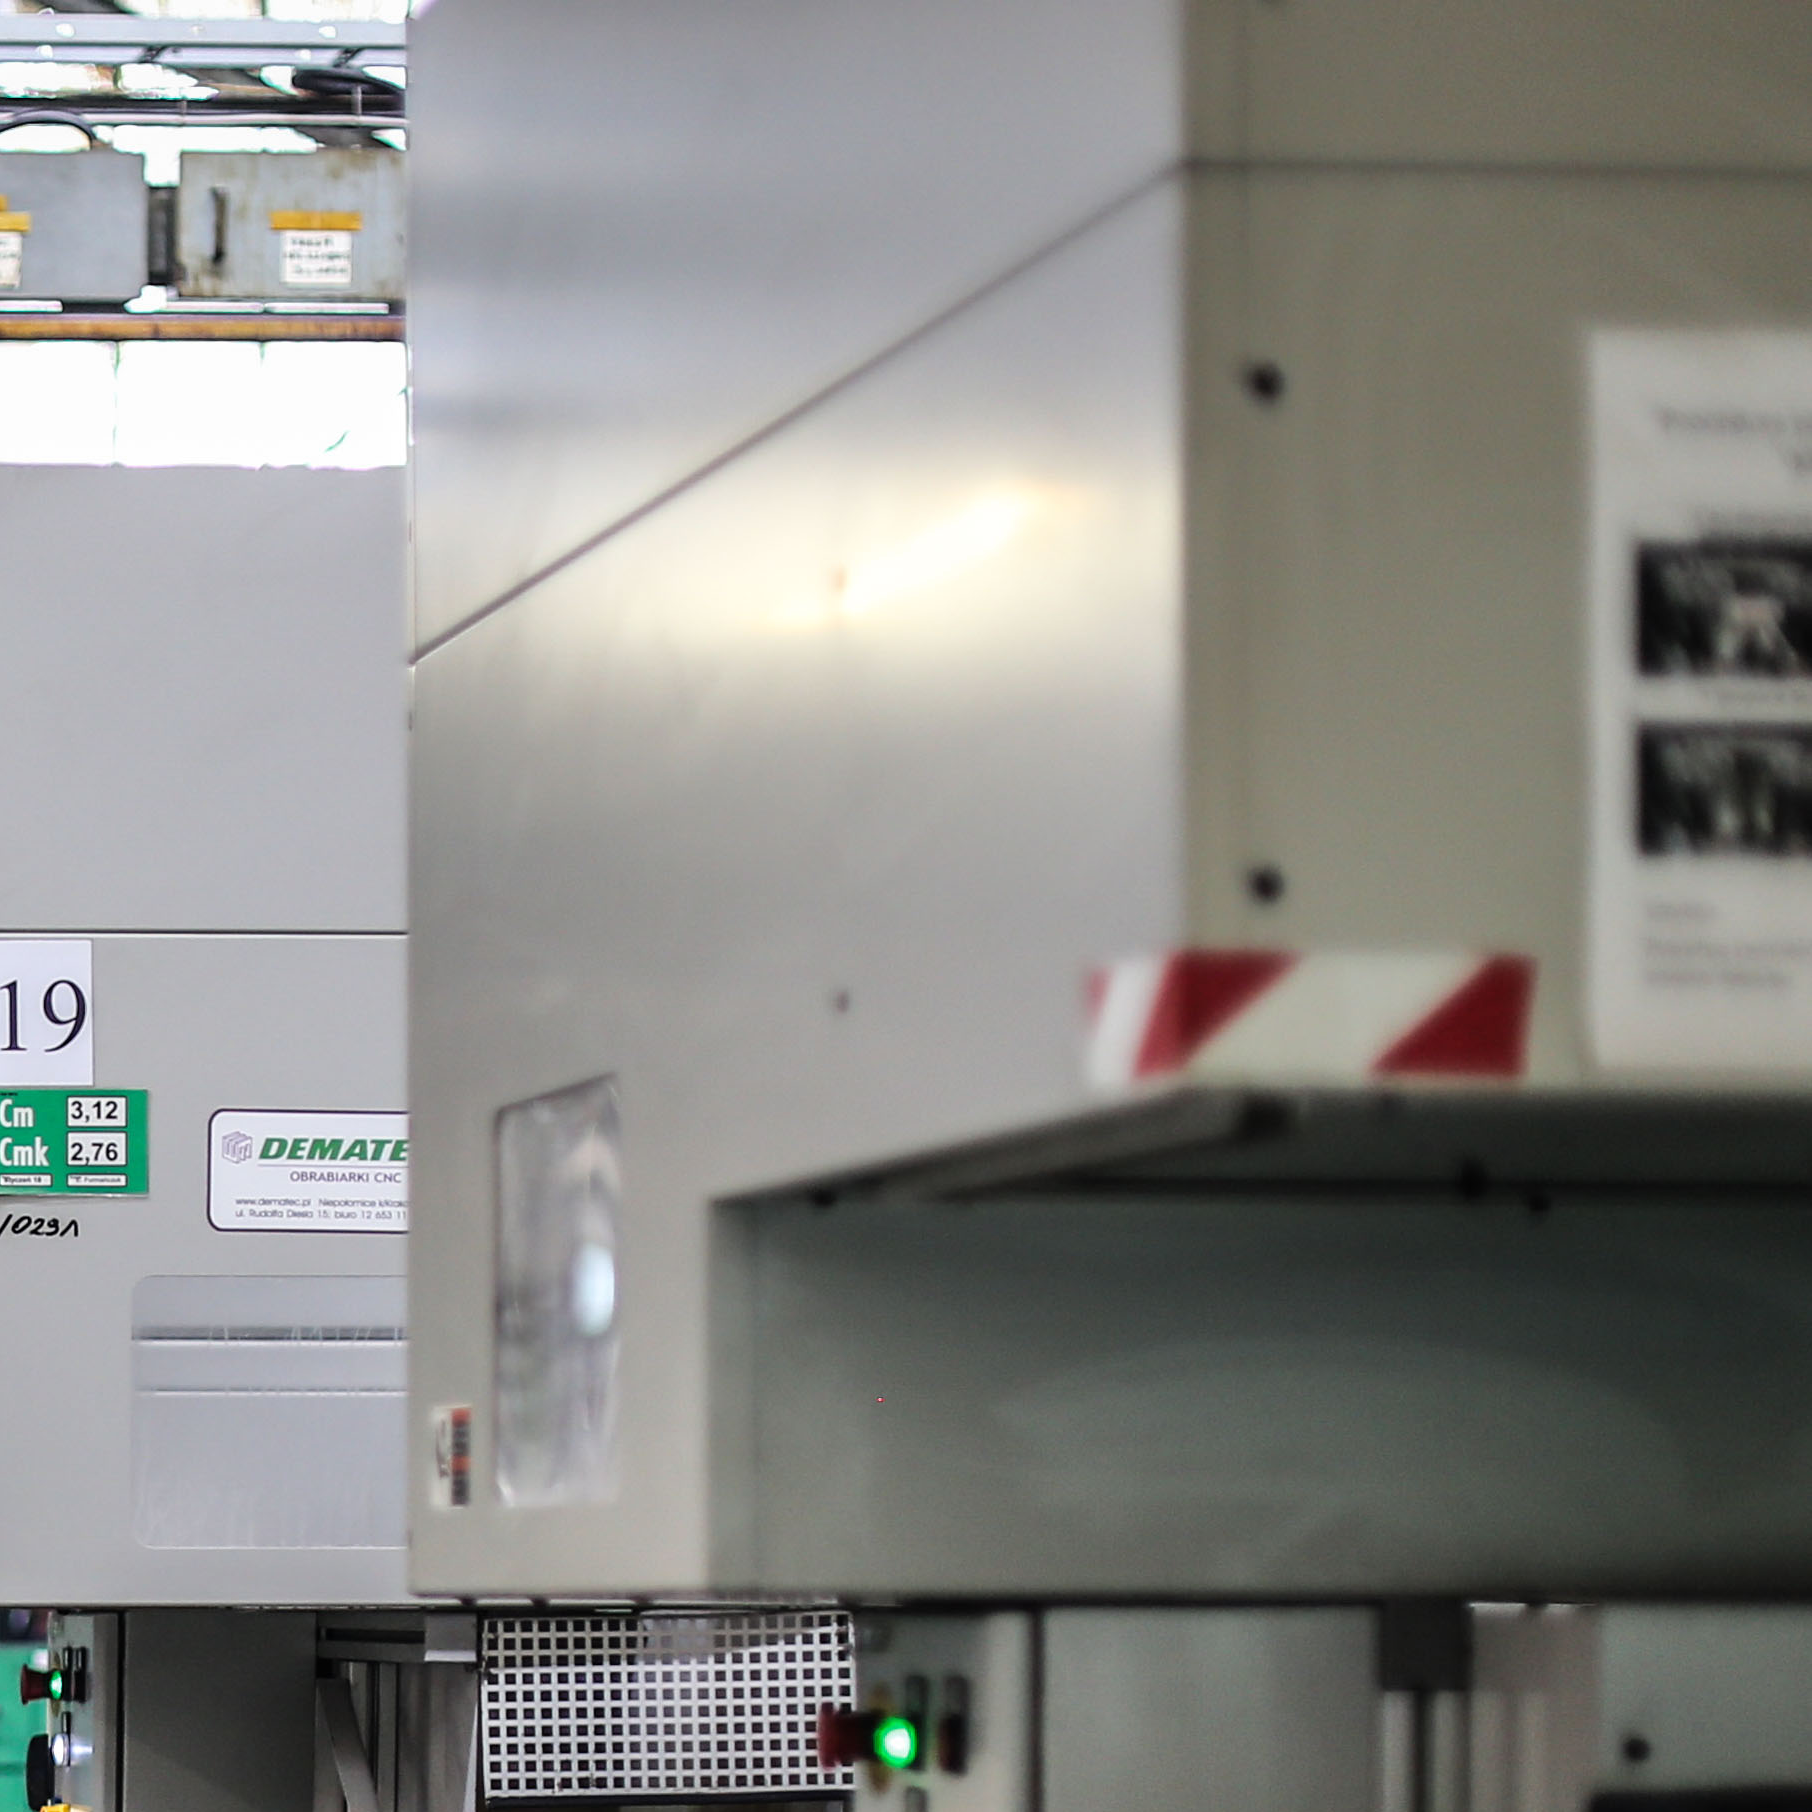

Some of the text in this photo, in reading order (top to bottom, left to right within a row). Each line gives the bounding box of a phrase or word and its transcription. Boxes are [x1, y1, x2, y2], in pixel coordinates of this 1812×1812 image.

[71, 1101, 118, 1122] 3,12
[70, 1142, 119, 1166] 2,76
[289, 1171, 402, 1183] OBRABIARKI CNC
